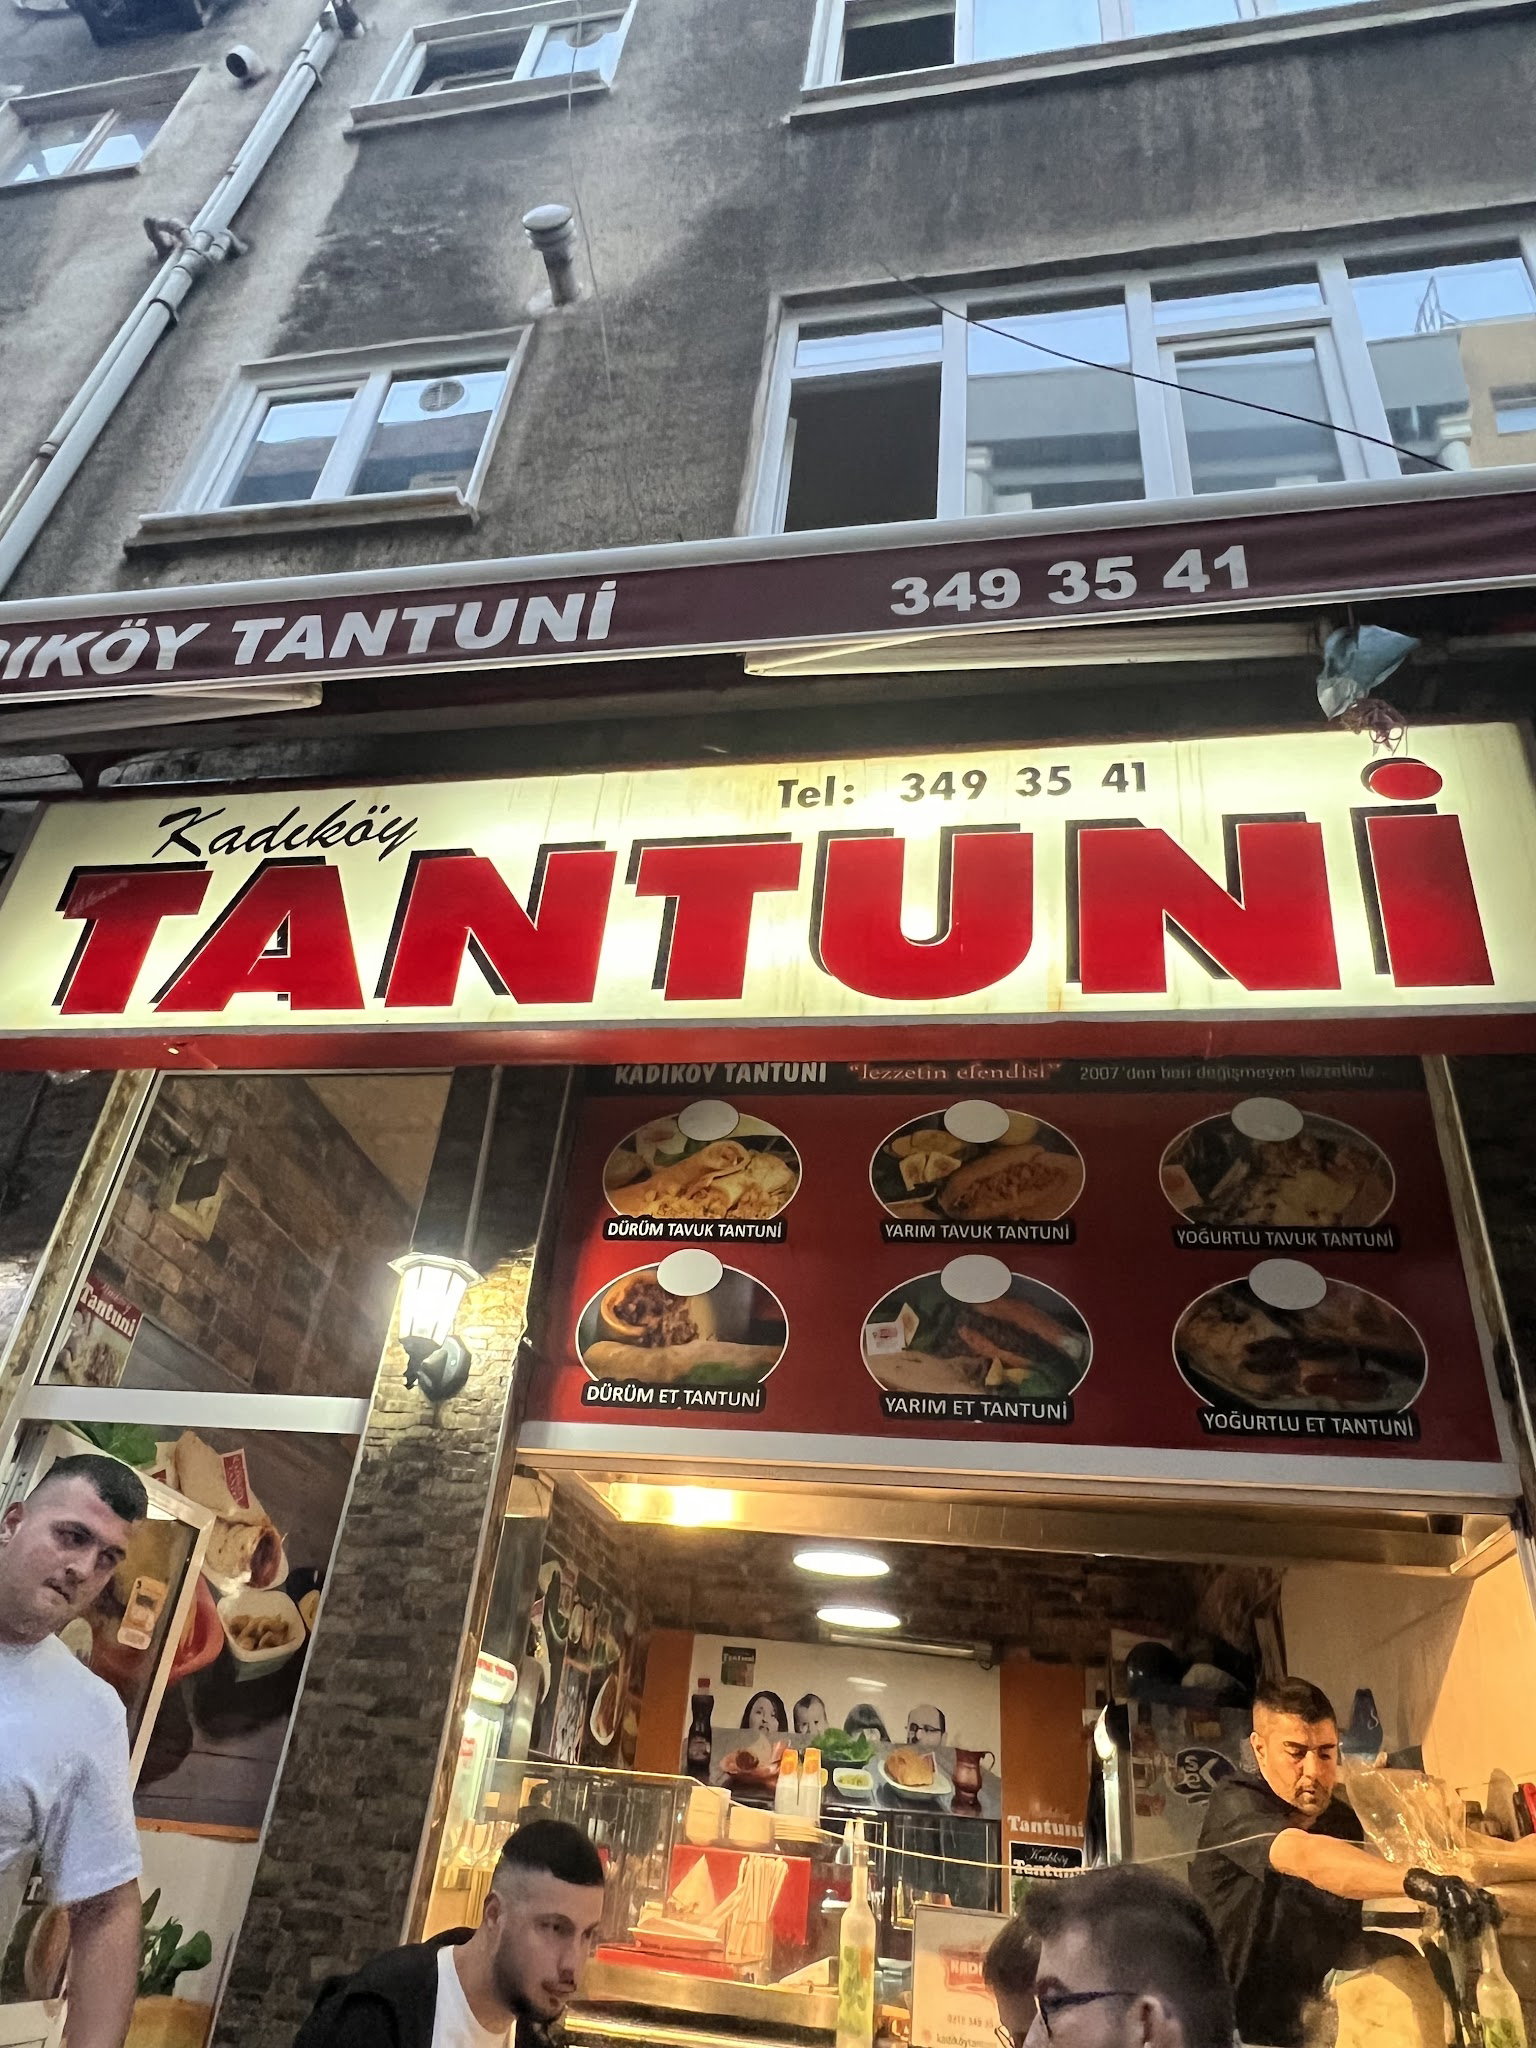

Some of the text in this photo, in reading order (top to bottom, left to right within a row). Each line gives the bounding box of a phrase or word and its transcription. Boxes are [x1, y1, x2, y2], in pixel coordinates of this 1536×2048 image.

[890, 544, 1250, 616] 349 35 41
[0, 579, 617, 680] IKÖY TANTUNİ
[777, 761, 1147, 809] Tel: 349 35 41
[607, 1220, 783, 1239] DÜRÜM TAVUK TANTUNİ
[885, 1223, 1070, 1241] YARIM TAVUK TANTUNİ
[1176, 1227, 1395, 1248] YOĞURTLU TAVUK TANTUNİ
[80, 1282, 137, 1338] Tantuni
[586, 1382, 762, 1408] DÜRÜM ET TANTUNİ
[885, 1396, 1068, 1421] YARIM ET TANTUNİ
[1203, 1410, 1415, 1437] YOĞURTLU ET TANTUNİ
[1007, 1815, 1085, 1838] Tantuni
